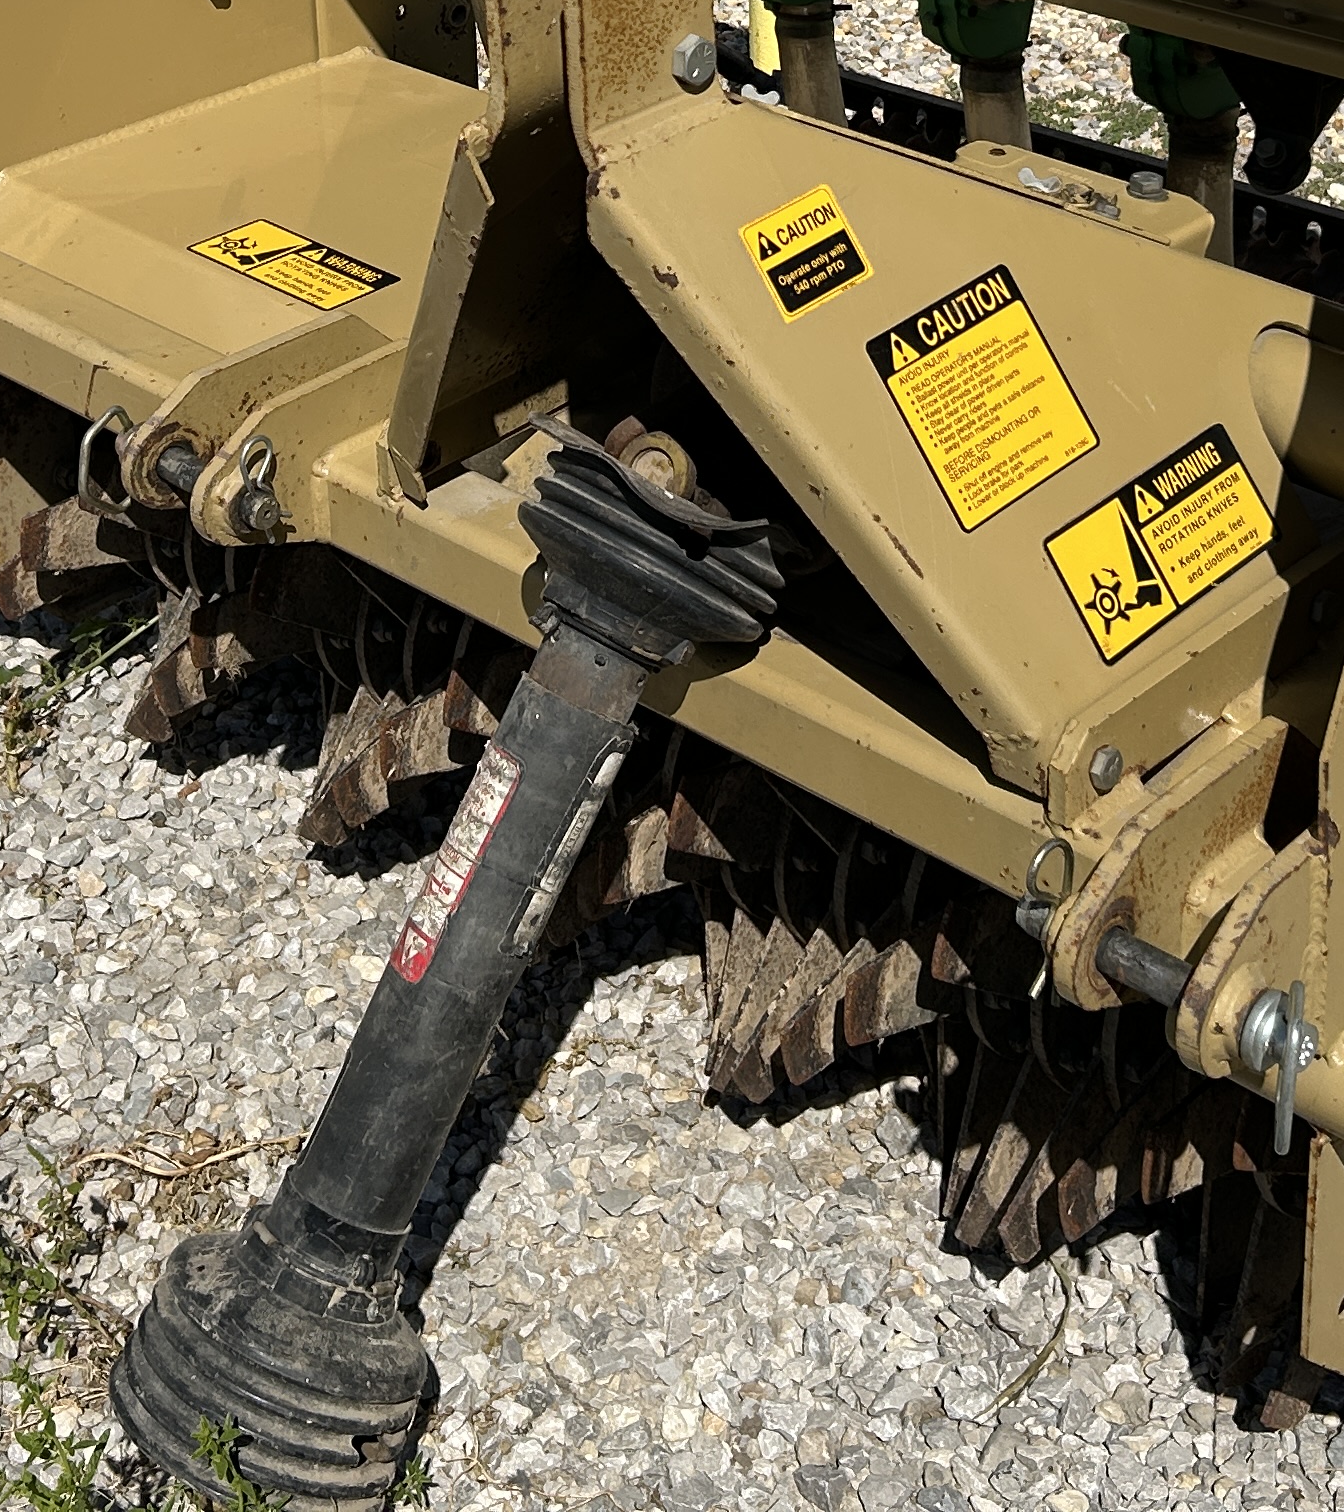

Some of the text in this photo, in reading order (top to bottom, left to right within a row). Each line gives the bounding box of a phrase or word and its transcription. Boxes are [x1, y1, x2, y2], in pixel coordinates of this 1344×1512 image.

[776, 202, 837, 246] CAUTION
[324, 254, 383, 283] WARNING
[778, 242, 848, 286] Operate only with
[793, 280, 809, 295] 540
[810, 271, 827, 287] rpm
[826, 260, 845, 276] PTO
[917, 272, 1012, 346] CAUTION
[896, 348, 951, 386] AVOID INJURY
[909, 334, 1001, 394] READ OPERATOR'S MANUAL
[942, 404, 1041, 474] BEFORE DISMOUNTING OR
[947, 449, 991, 484] SERVICING
[1152, 441, 1222, 501] WARNING
[1150, 470, 1241, 541] AVOID INJURY FROM
[1157, 491, 1240, 555] ROTATING KNIVES
[1177, 546, 1201, 570] Keep
[1200, 529, 1230, 553] hands,
[1228, 515, 1246, 536] feet
[1186, 567, 1204, 584] and
[1204, 544, 1240, 575] clothing
[1237, 527, 1259, 552] away
